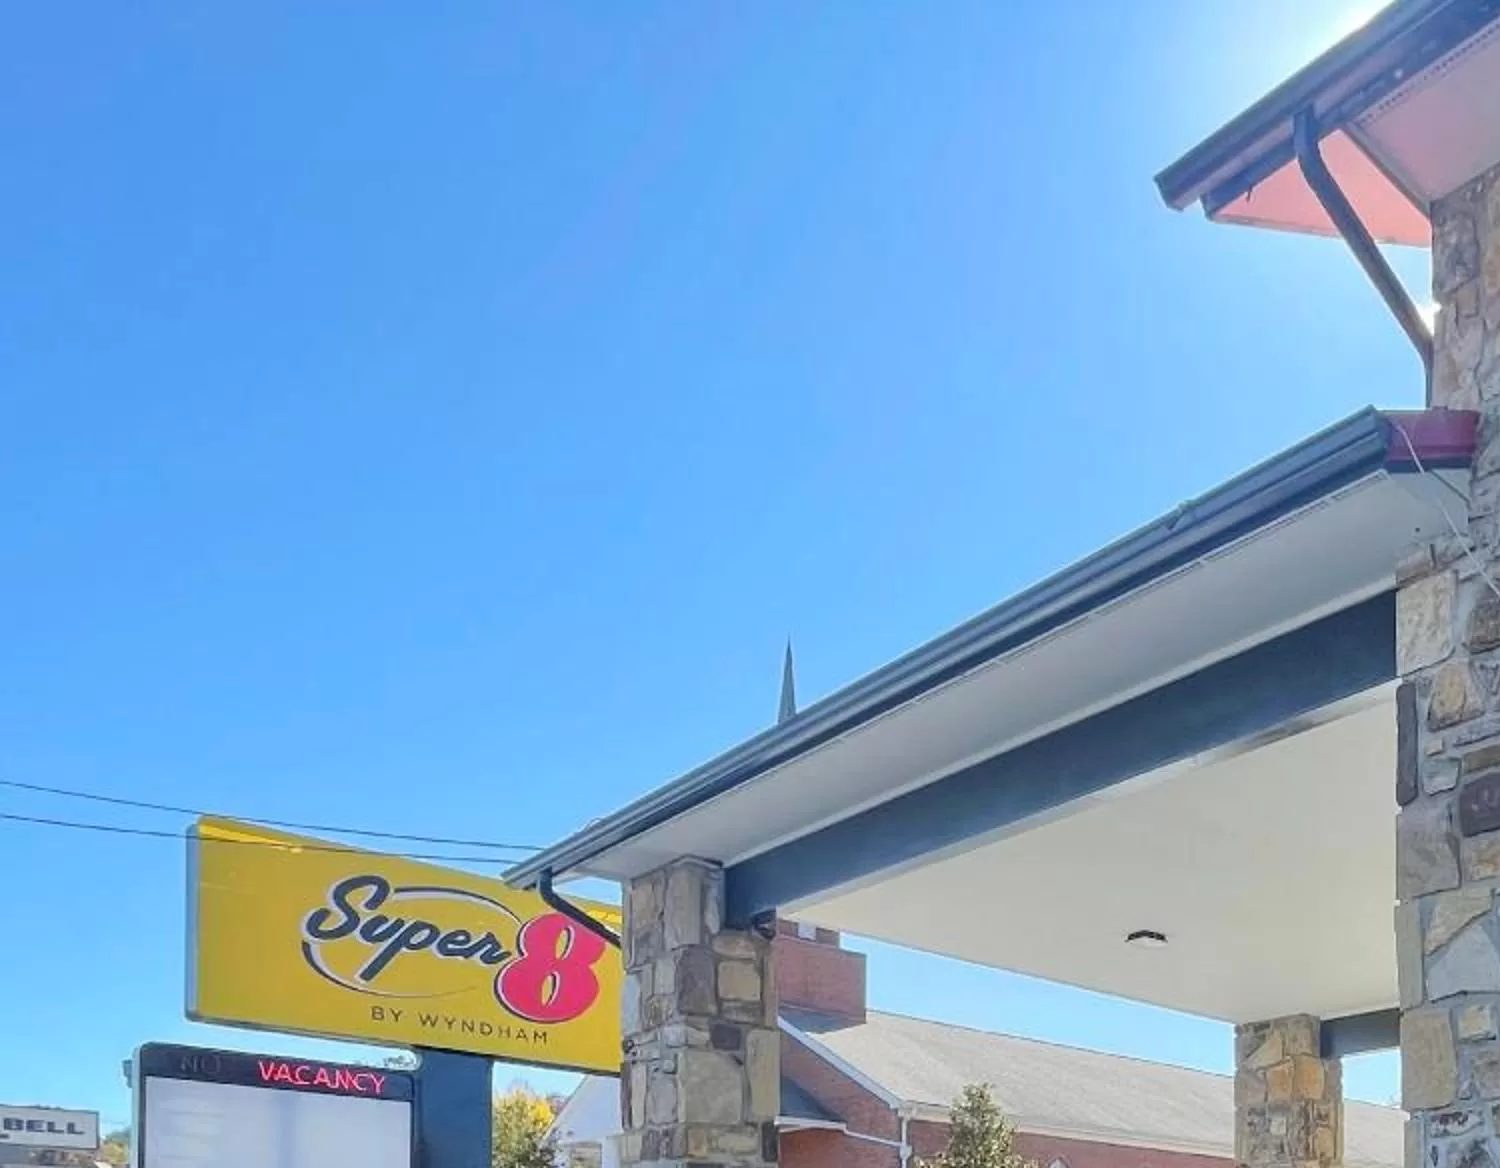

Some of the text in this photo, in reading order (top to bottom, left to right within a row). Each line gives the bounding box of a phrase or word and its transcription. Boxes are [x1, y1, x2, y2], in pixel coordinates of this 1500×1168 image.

[304, 874, 606, 1024] Super 8
[371, 1005, 548, 1045] BY WYNDHAM
[258, 1060, 384, 1094] VACANCY
